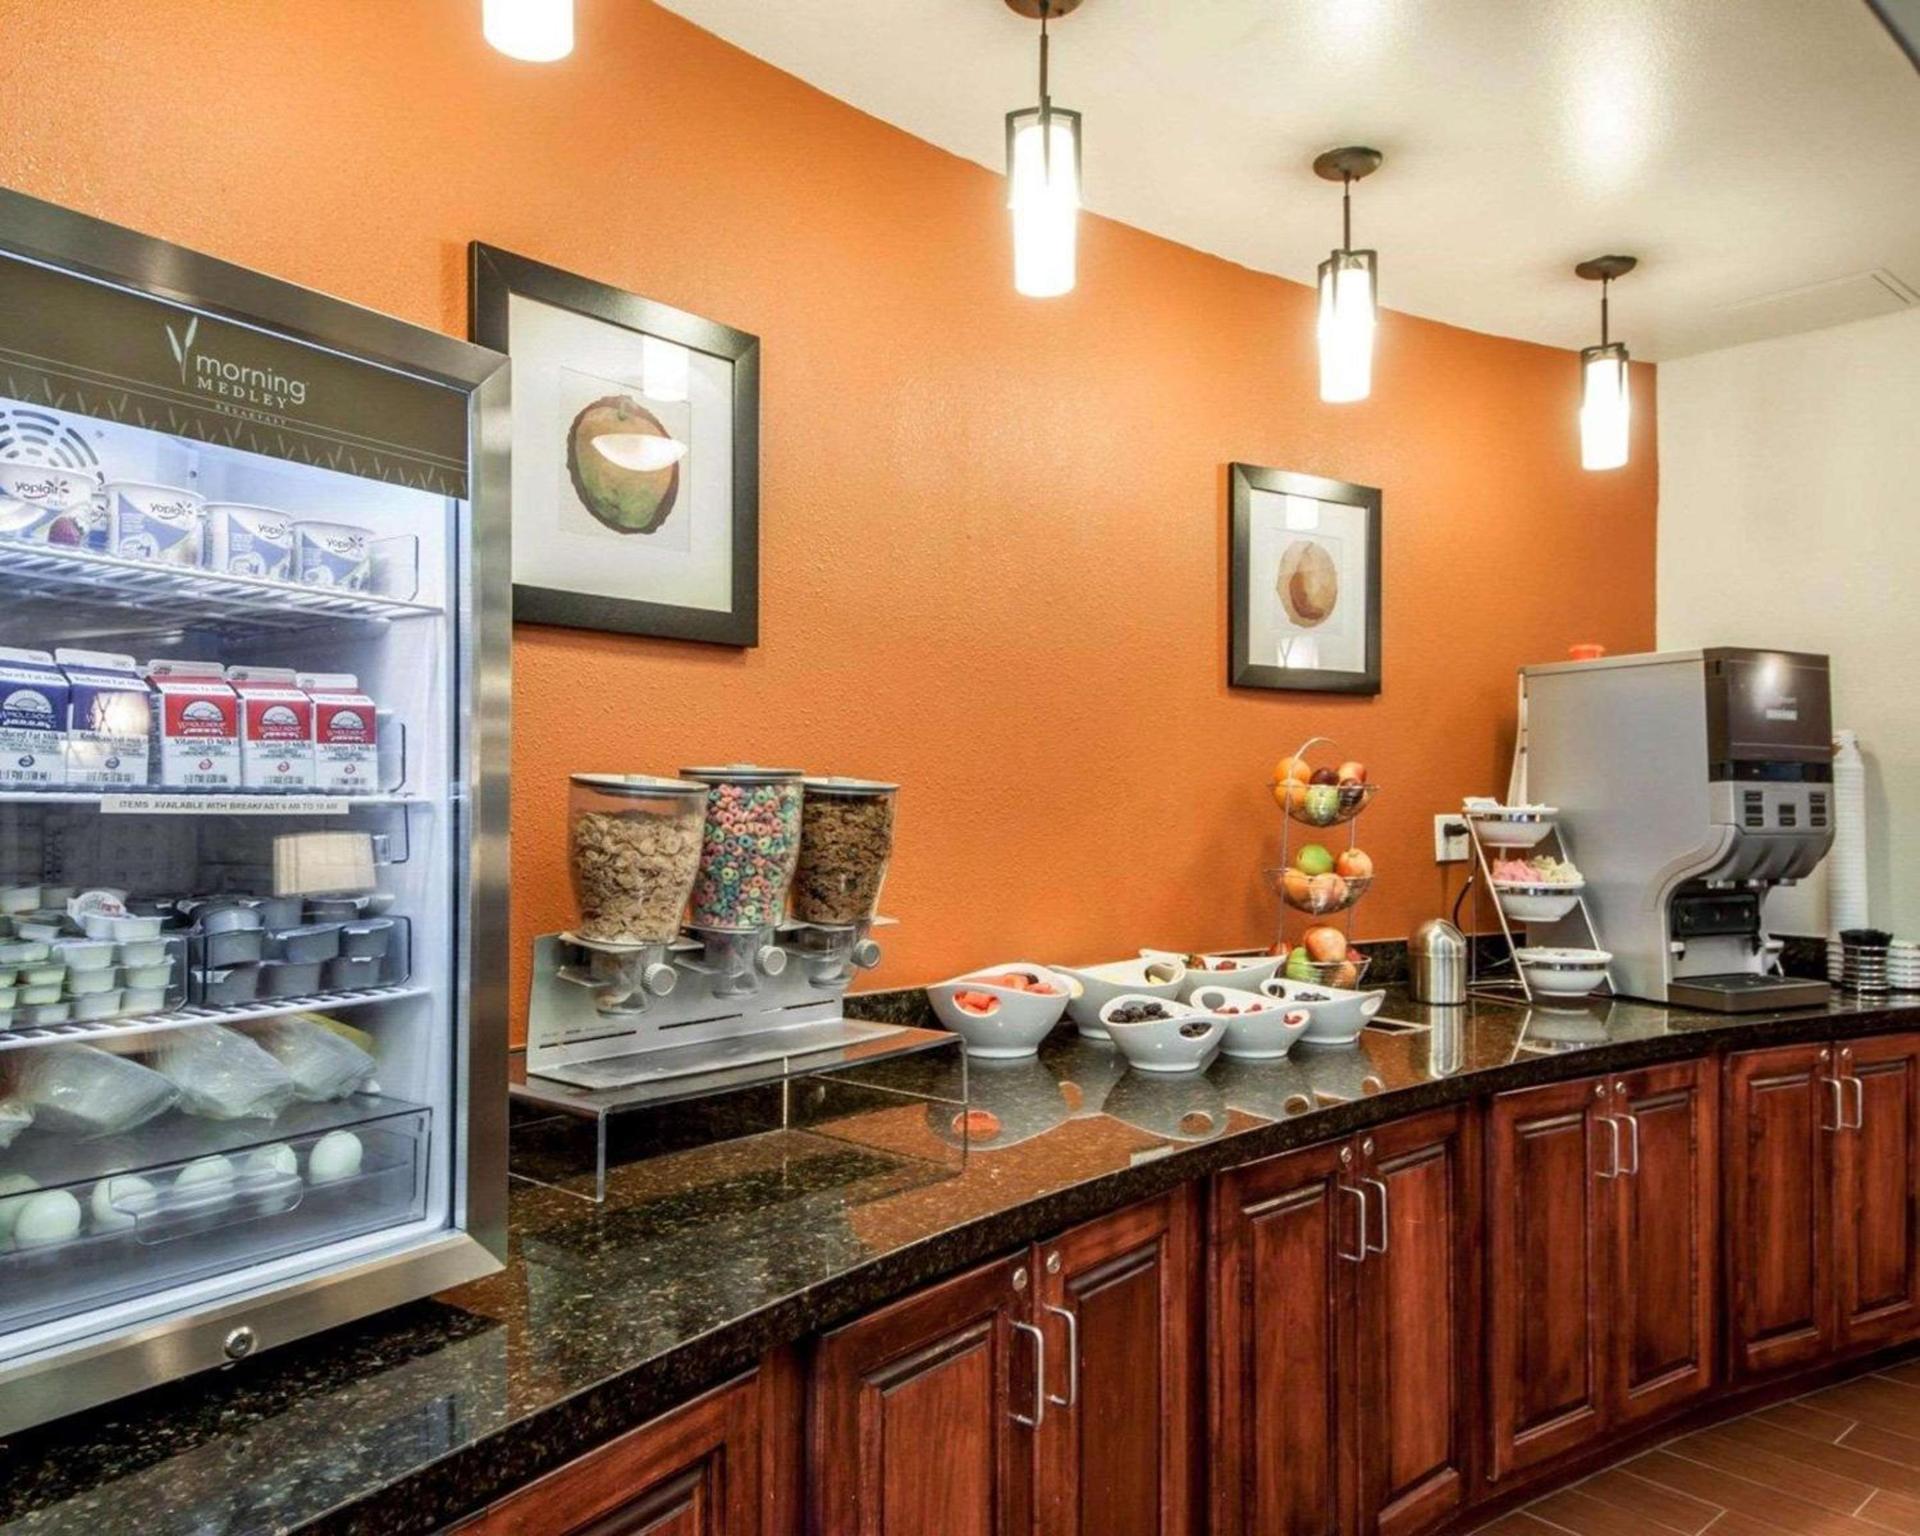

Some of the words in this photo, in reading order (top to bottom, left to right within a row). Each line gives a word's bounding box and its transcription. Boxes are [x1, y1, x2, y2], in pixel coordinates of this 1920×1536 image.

[196, 354, 306, 404] morning
[197, 376, 288, 409] MEDLEY
[119, 800, 149, 809] ITEMS
[154, 800, 204, 810] AVAILABLE
[206, 801, 228, 810] WITH
[229, 801, 280, 811] BREAKFAST
